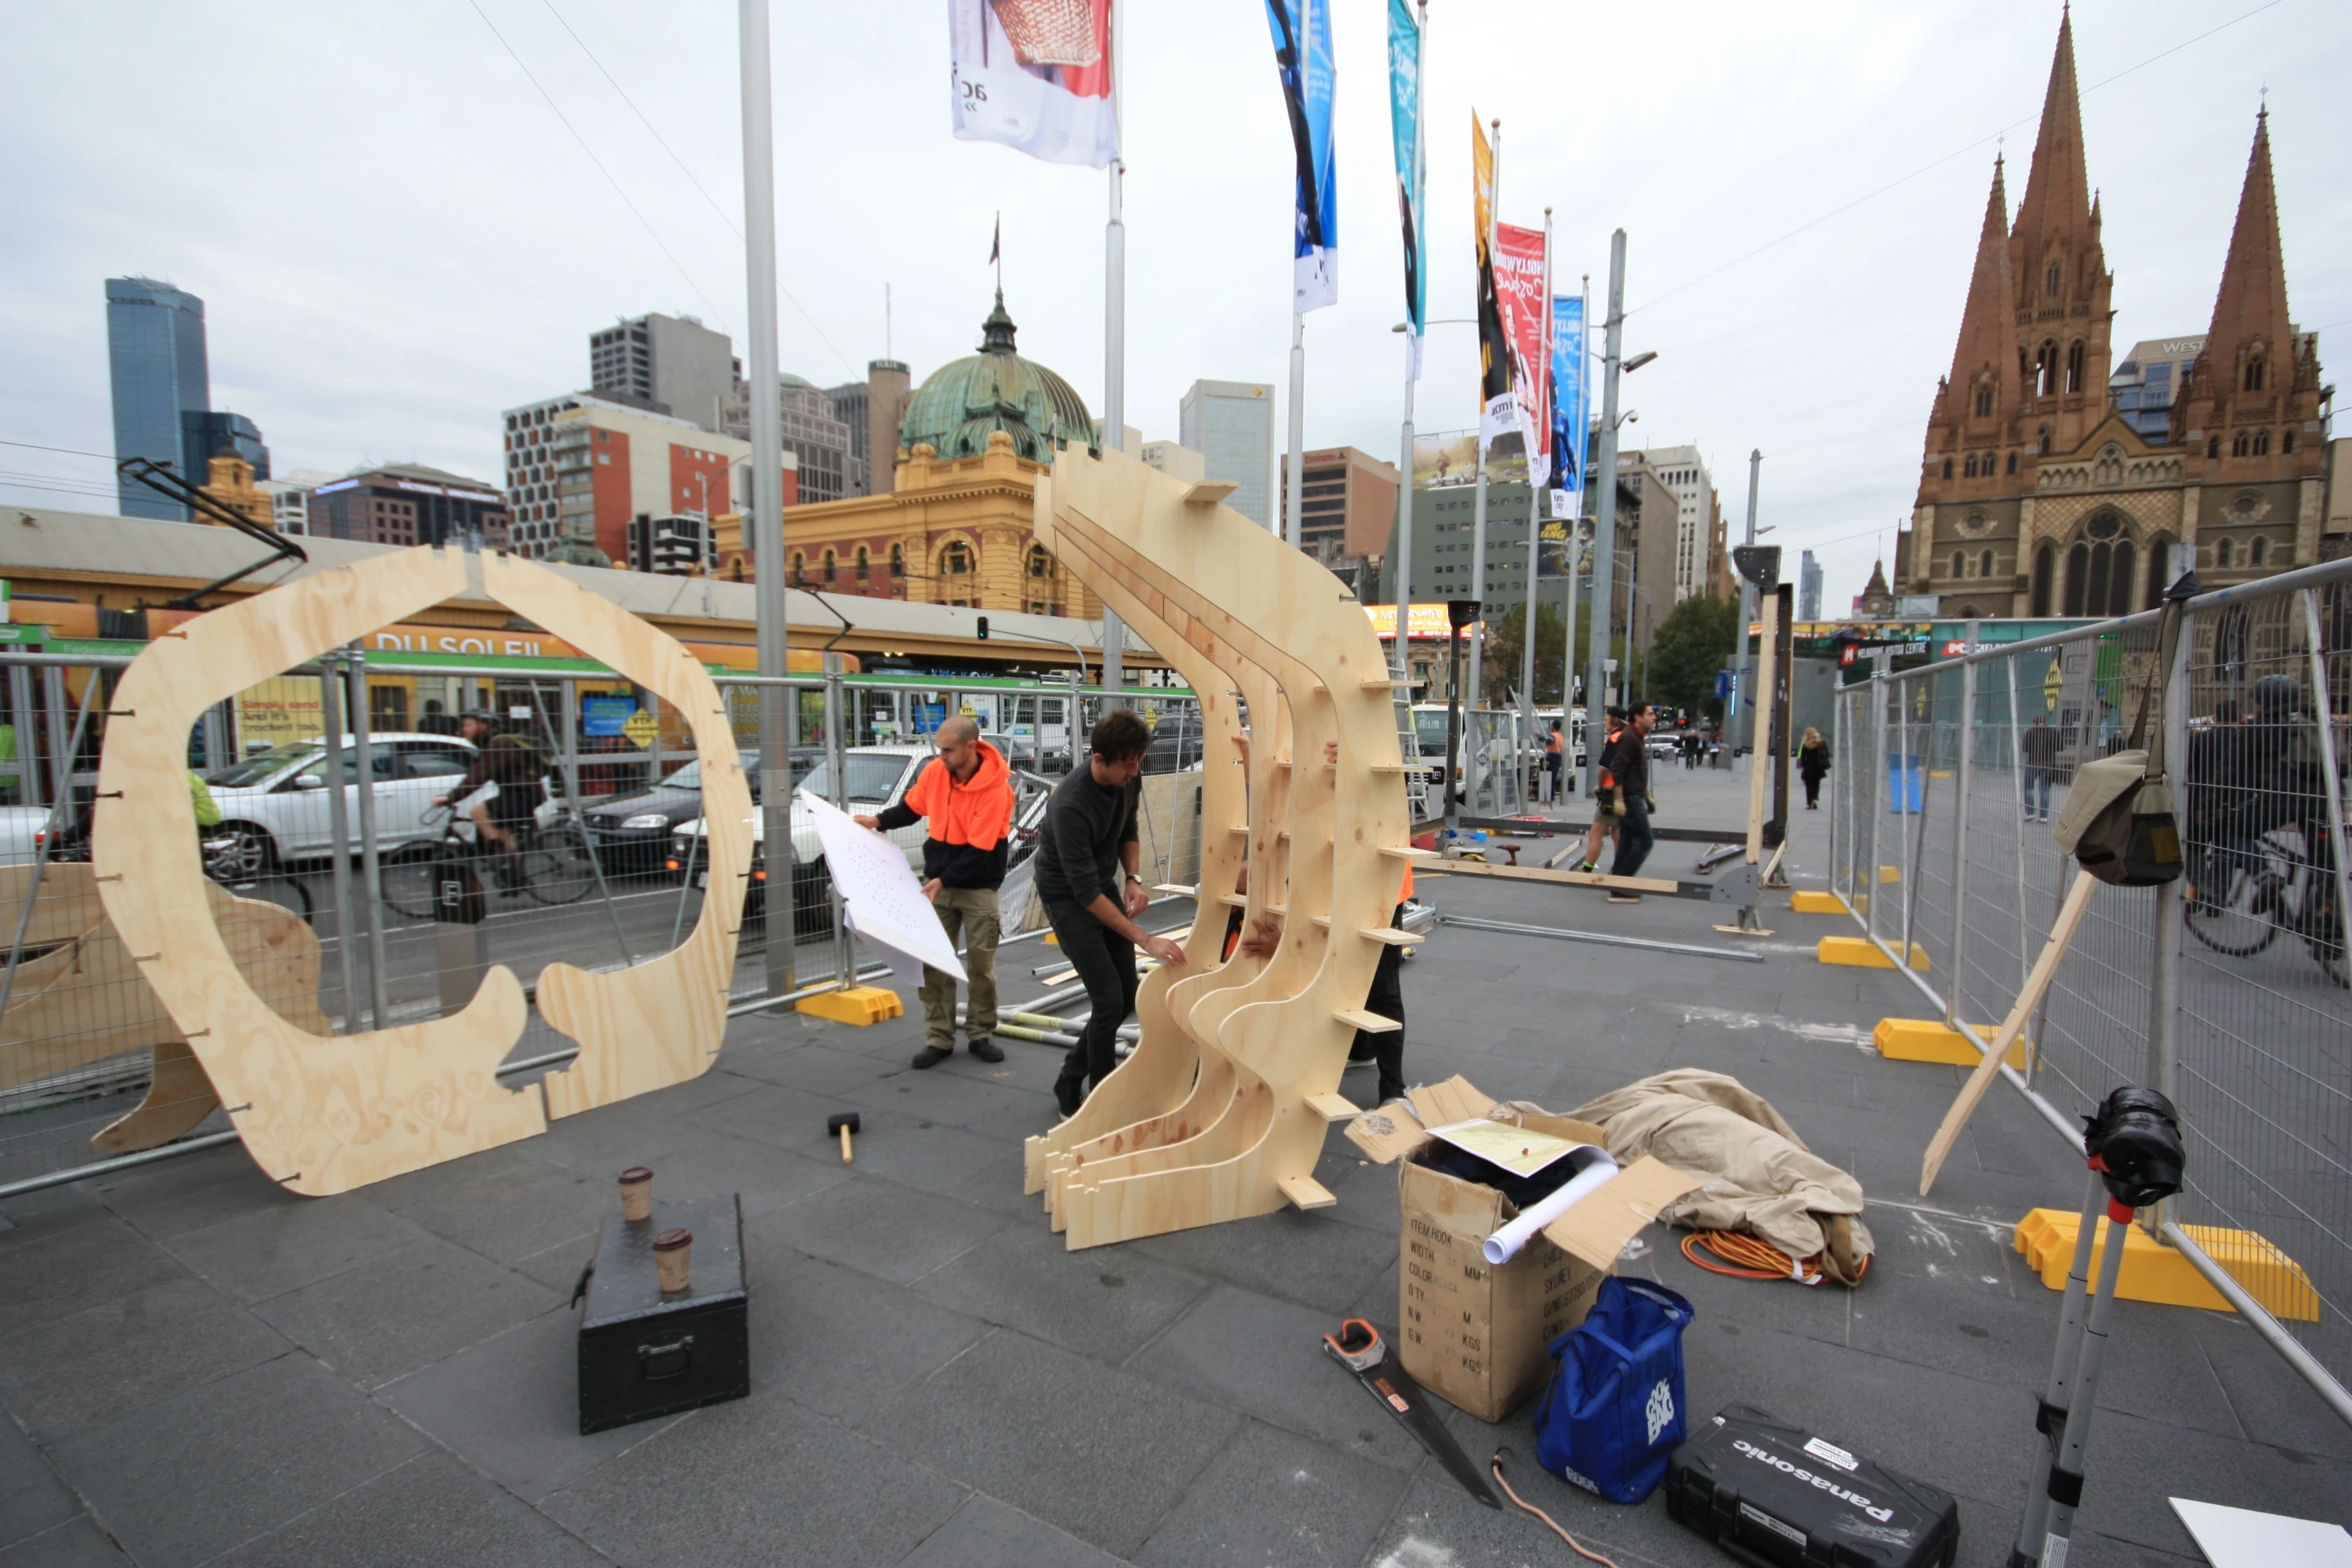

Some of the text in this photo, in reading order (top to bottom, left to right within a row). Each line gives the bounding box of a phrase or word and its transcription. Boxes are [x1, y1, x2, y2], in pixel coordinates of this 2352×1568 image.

[2163, 341, 2206, 354] WEST
[289, 700, 319, 709] send
[1464, 1265, 1481, 1282] MM
[1544, 1264, 1572, 1294] SYDNEY
[1462, 1333, 1481, 1352] KGS
[1462, 1356, 1481, 1374] KGS
[1732, 1439, 1894, 1523] Panasonic
